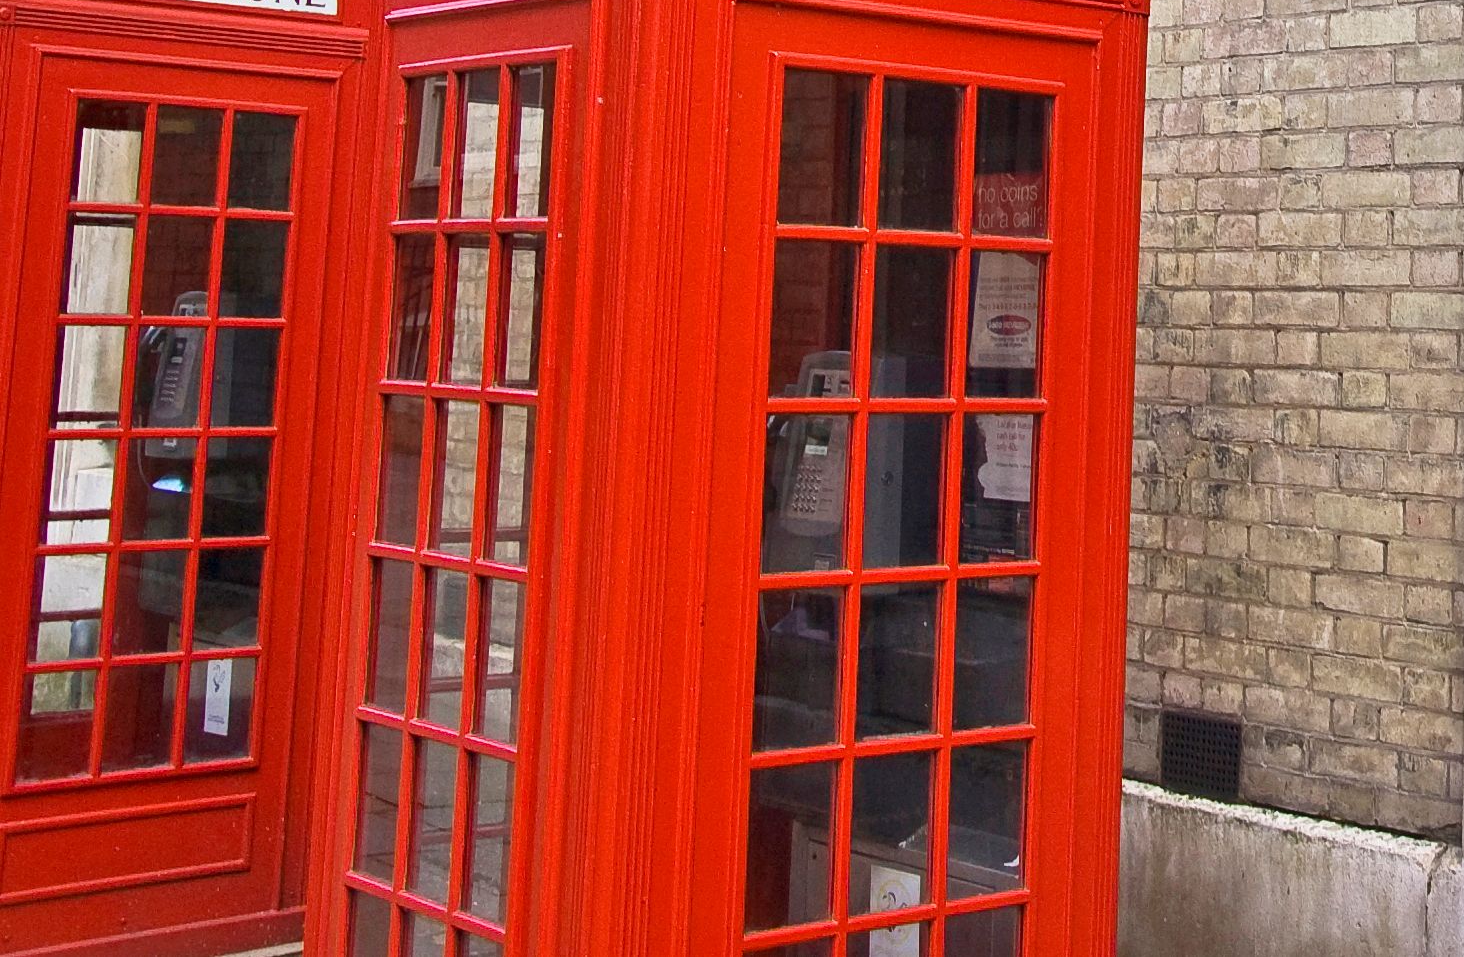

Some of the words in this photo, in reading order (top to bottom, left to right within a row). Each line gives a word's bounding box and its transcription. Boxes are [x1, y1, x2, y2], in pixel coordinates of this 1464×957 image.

[978, 186, 996, 204] no
[1000, 183, 1038, 203] coins
[977, 208, 995, 229] for
[999, 211, 1009, 229] a
